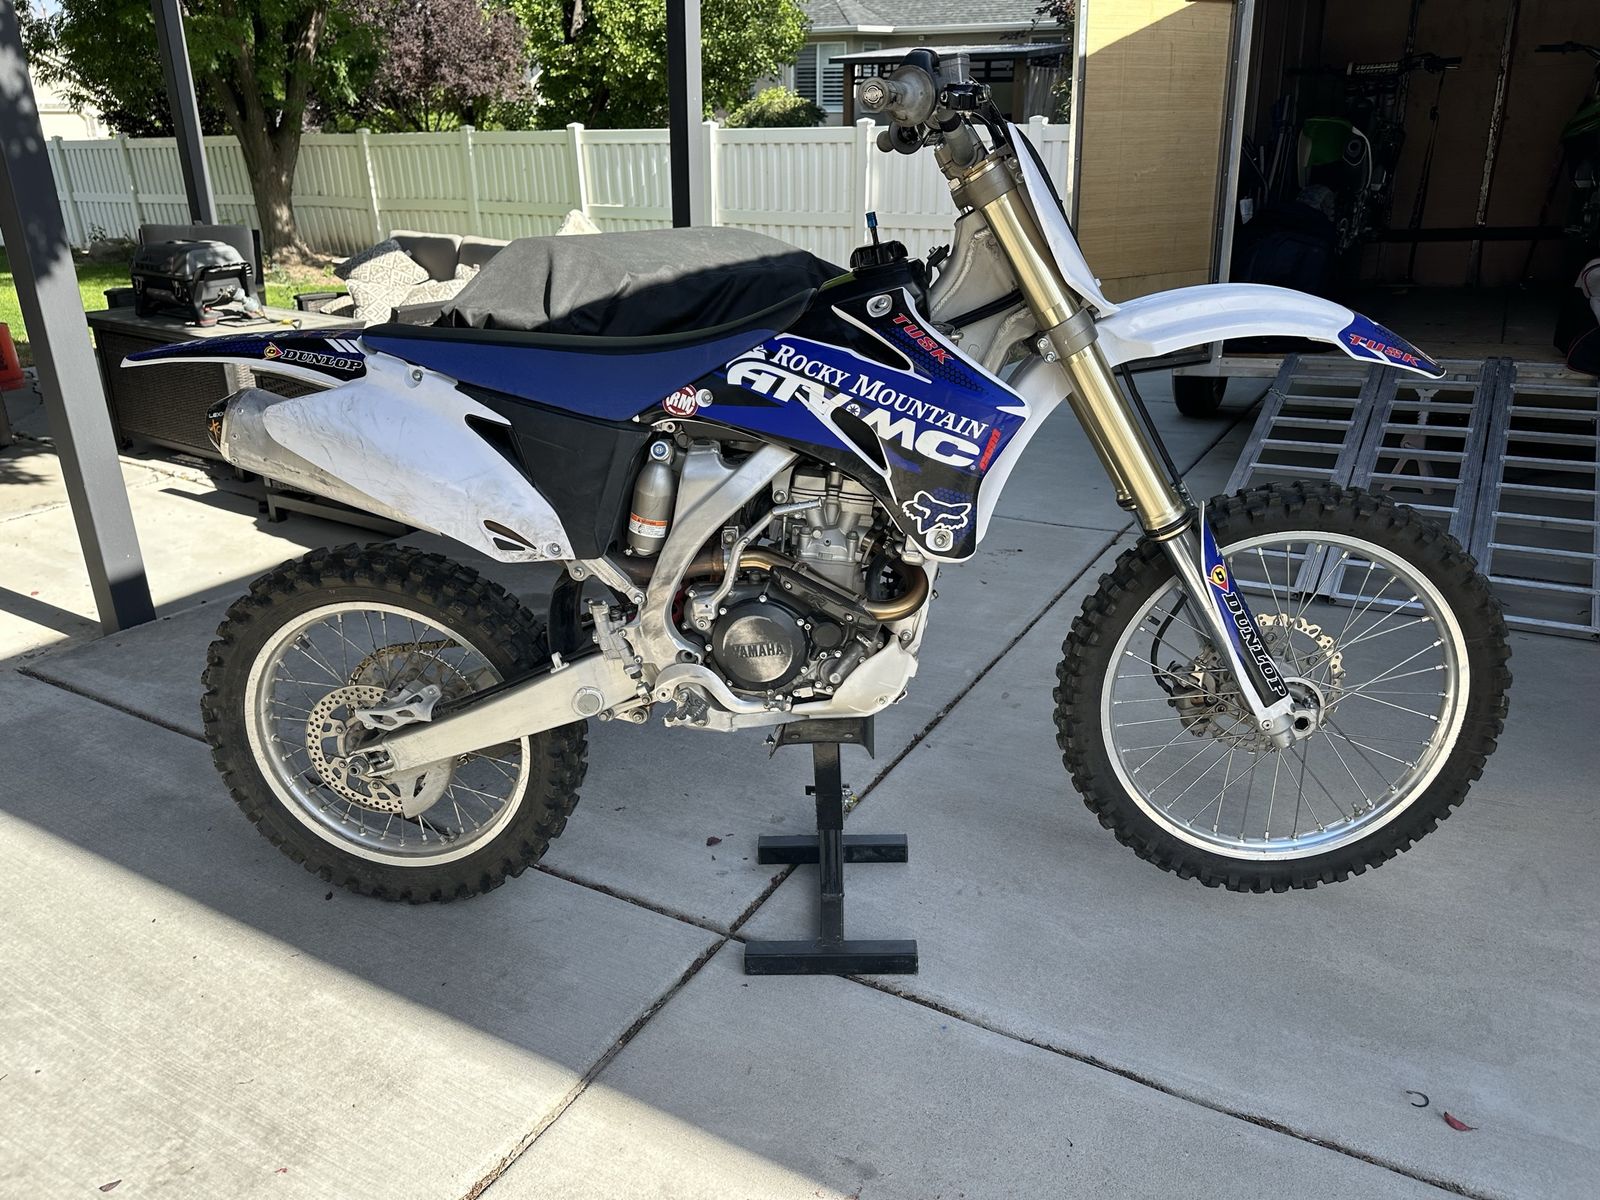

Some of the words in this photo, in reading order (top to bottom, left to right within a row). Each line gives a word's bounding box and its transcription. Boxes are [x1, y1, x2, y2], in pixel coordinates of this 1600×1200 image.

[280, 348, 363, 371] DUNLOP
[892, 312, 954, 365] TUSK
[1349, 333, 1421, 367] TUSK
[770, 344, 851, 387] ROCKY
[848, 374, 989, 439] MOUNTAIN
[733, 642, 785, 659] YAMAHA
[1222, 592, 1287, 697] DUNLOP
